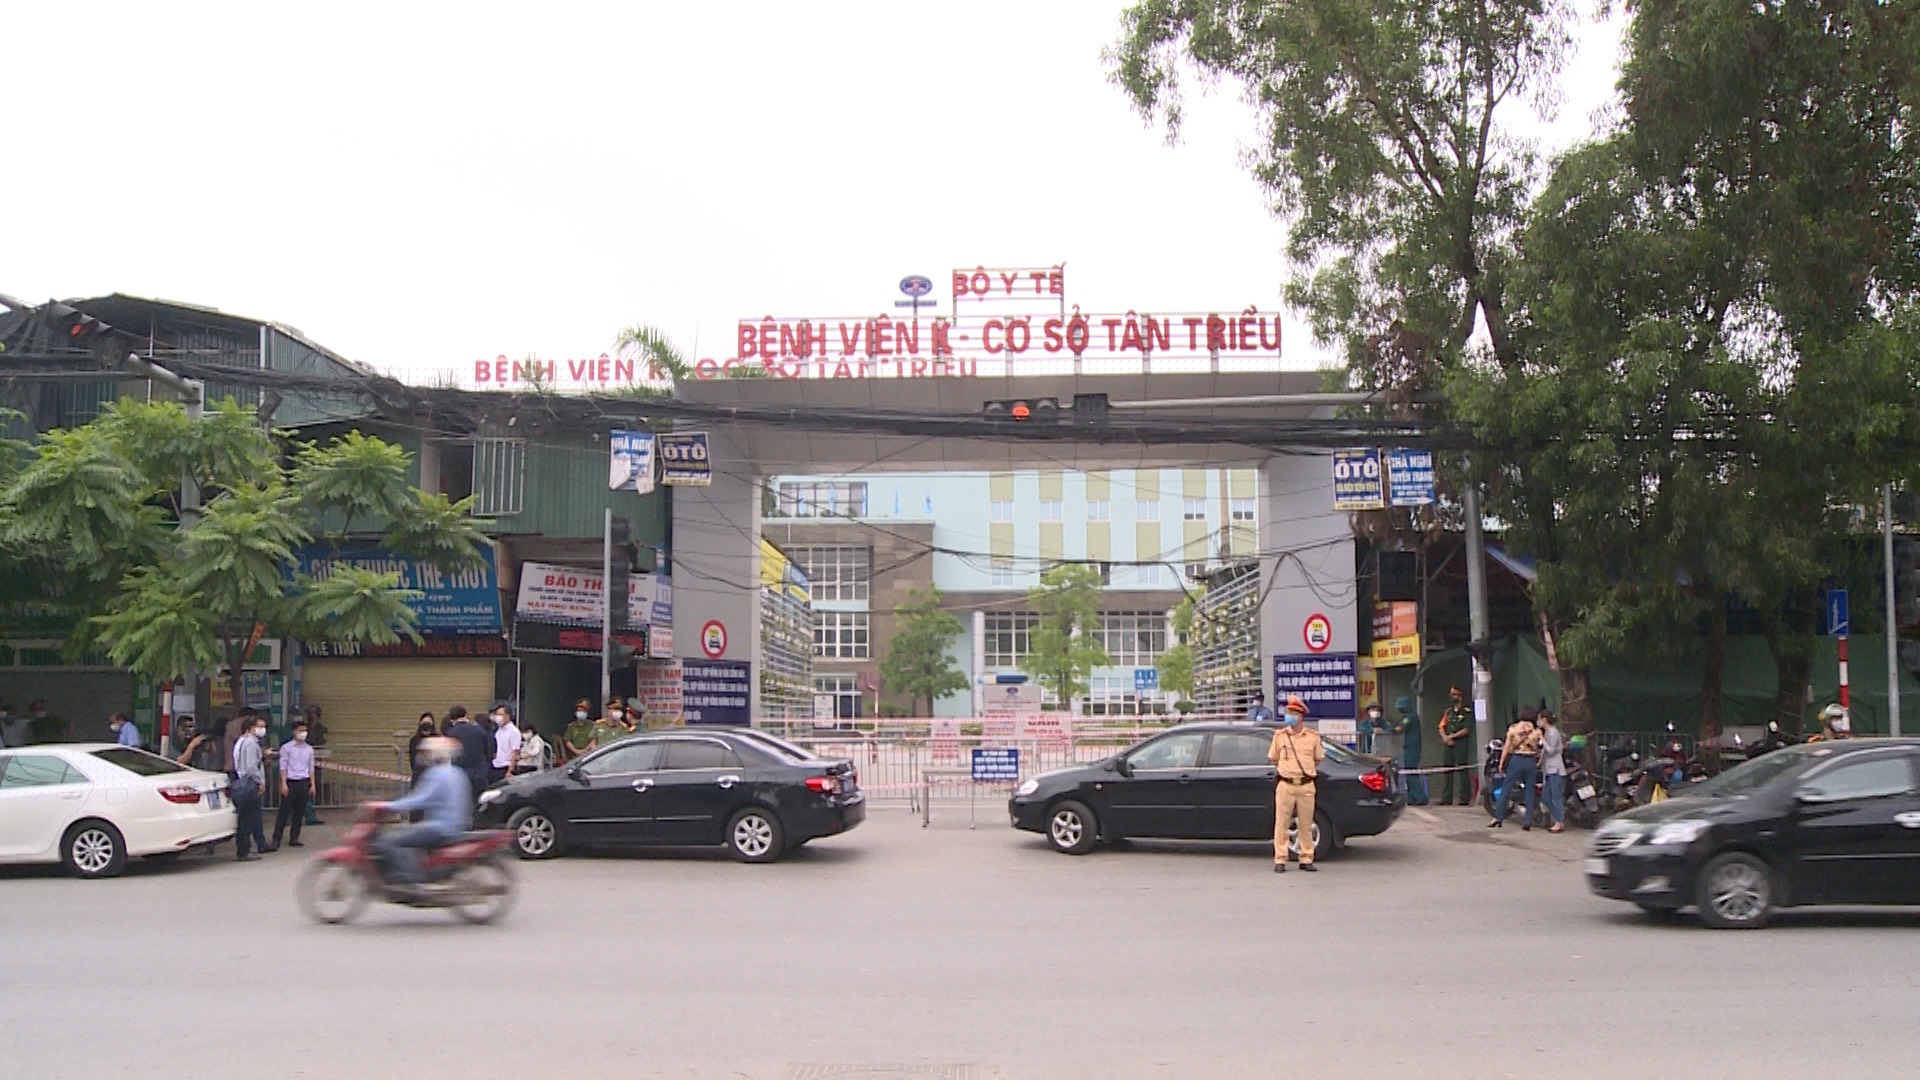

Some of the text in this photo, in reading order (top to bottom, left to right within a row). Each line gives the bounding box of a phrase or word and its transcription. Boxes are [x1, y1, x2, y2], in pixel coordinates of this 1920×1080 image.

[953, 261, 1067, 302] BỘ Y TẾ
[931, 321, 954, 355] K
[982, 315, 1032, 354] CƠ
[1043, 303, 1090, 355] SỞ
[1101, 309, 1170, 352] TÂN
[1182, 303, 1281, 351] TRIỀU
[474, 353, 554, 388] BỆNH
[567, 351, 634, 387] VIỆN
